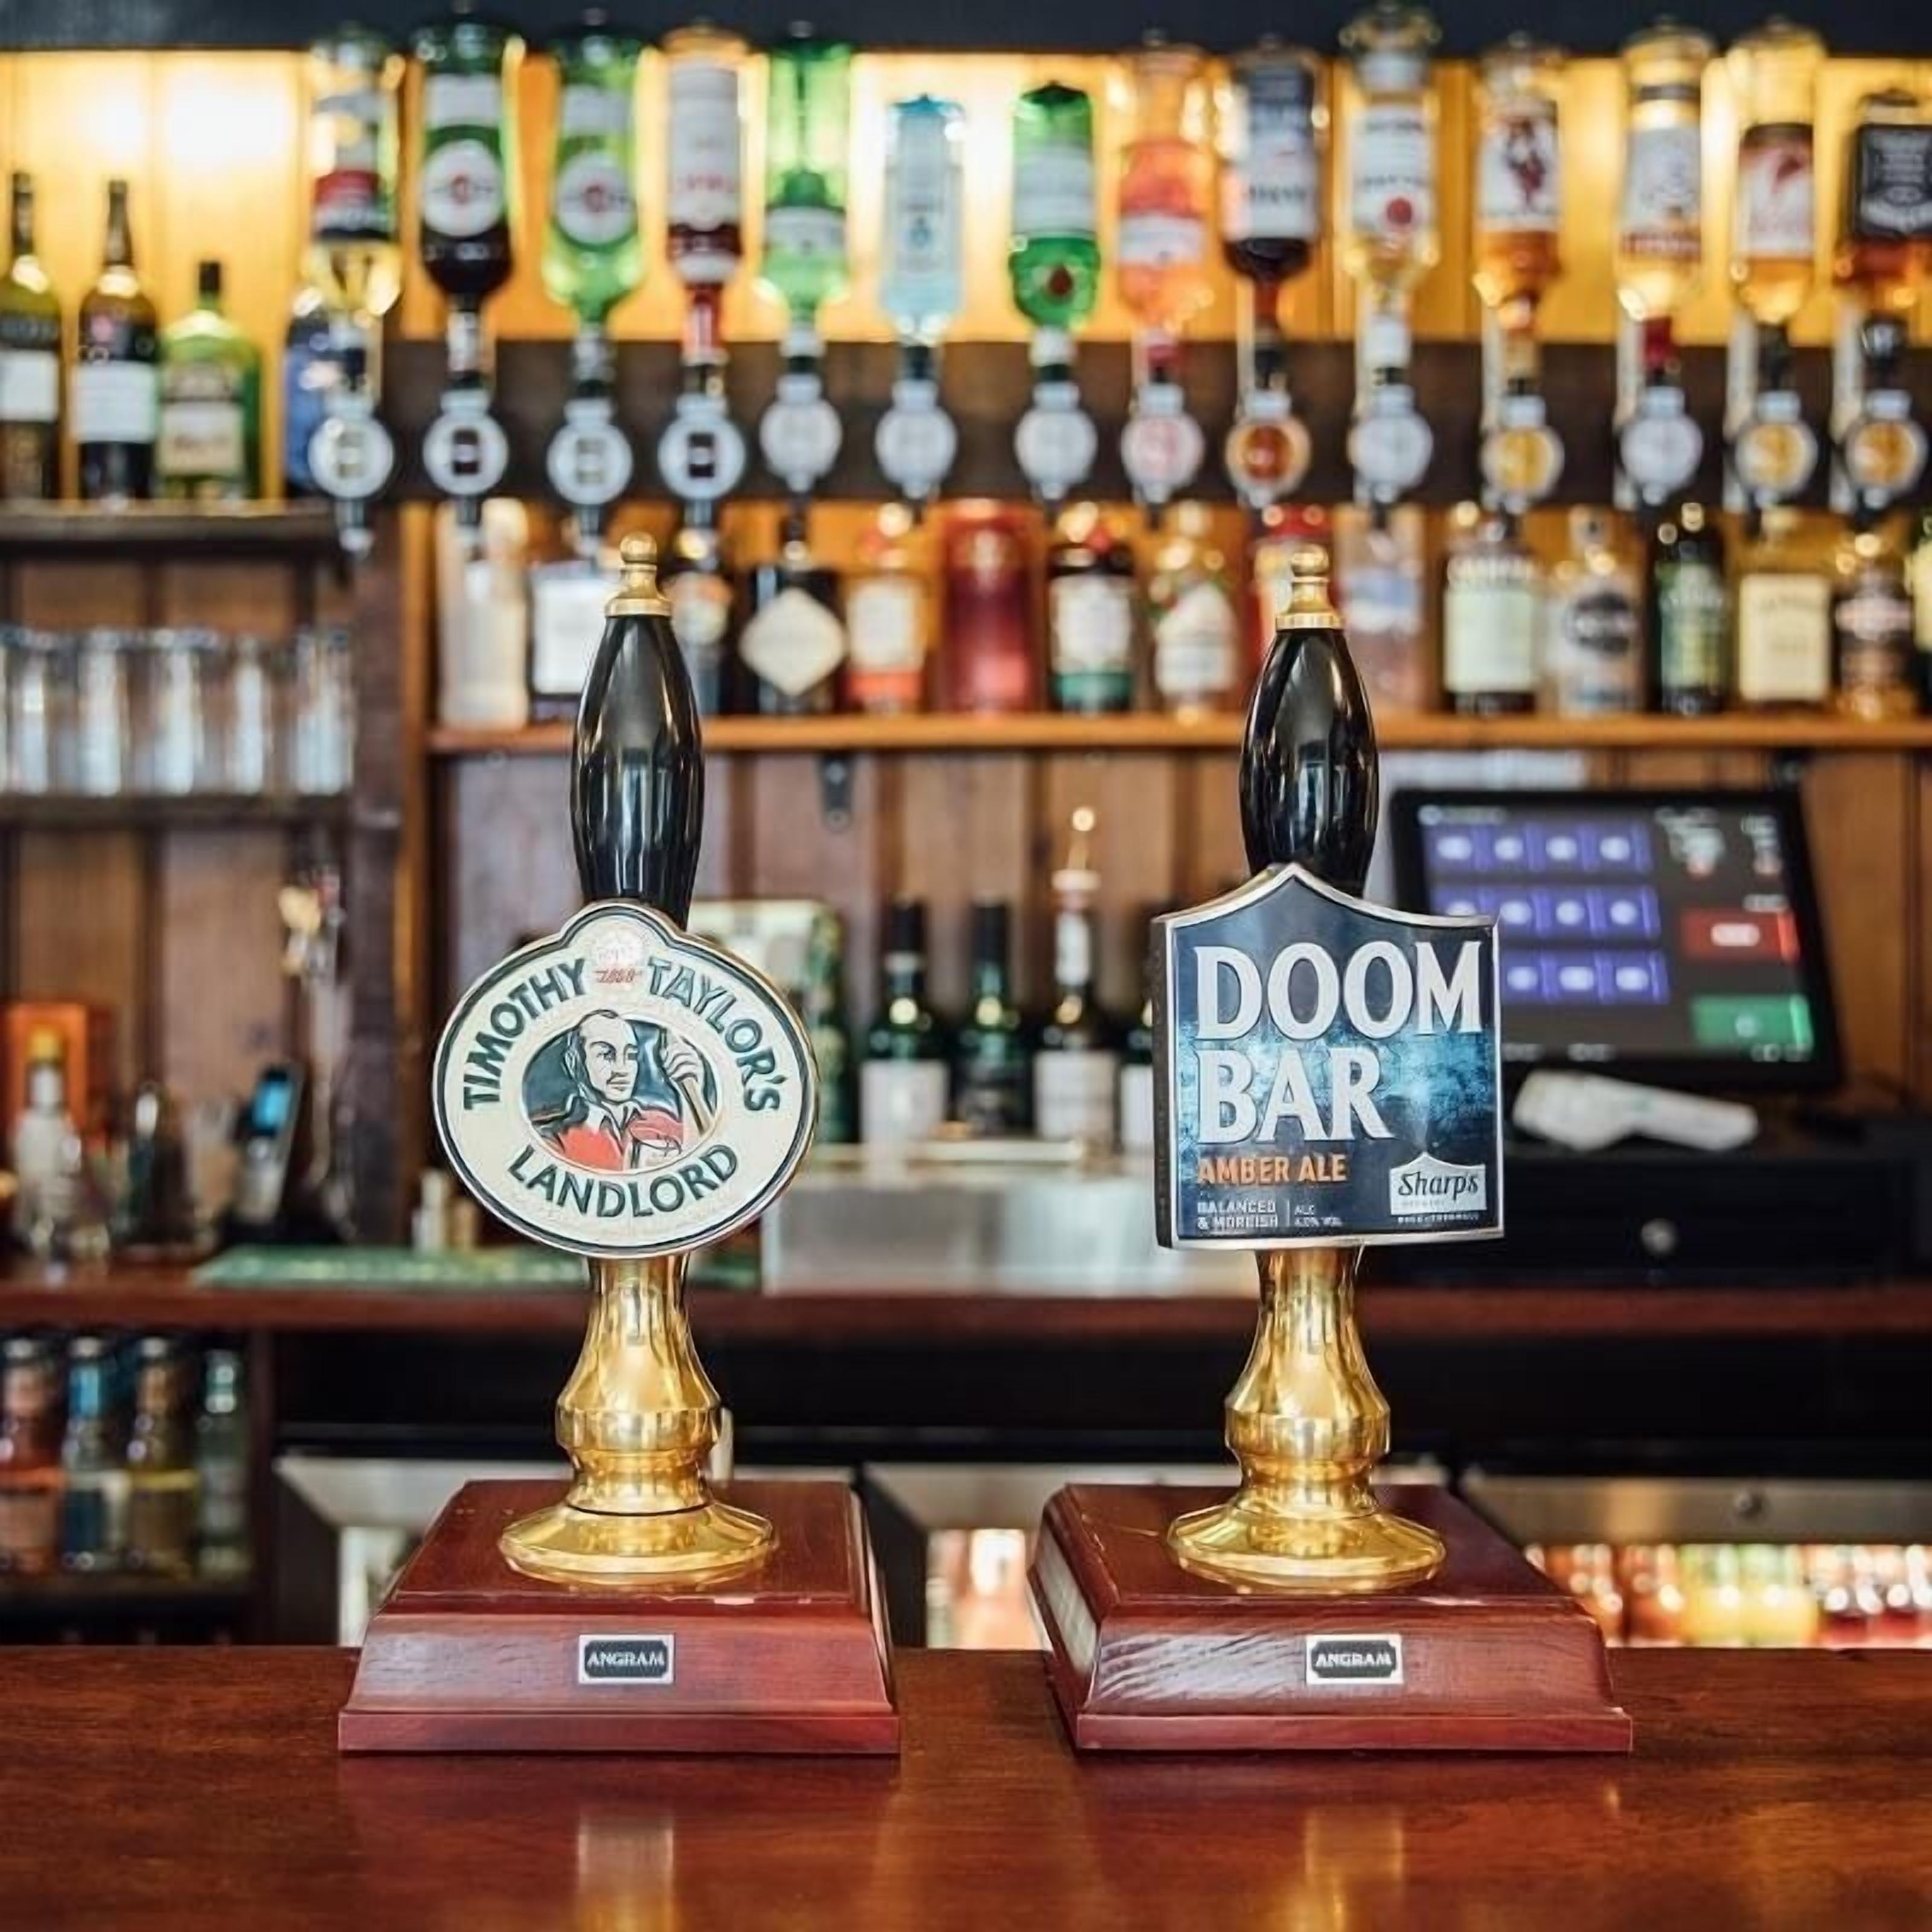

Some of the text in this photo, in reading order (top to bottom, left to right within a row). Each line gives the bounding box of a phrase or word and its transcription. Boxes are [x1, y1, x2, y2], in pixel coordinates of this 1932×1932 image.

[1193, 940, 1483, 1041] DOOM
[464, 956, 788, 1112] TIMOTHY TAYLOR'S
[1194, 1047, 1397, 1144] BAR
[507, 1144, 740, 1218] LANDLORD
[1197, 1152, 1348, 1185] AMBER ALE
[1398, 1171, 1479, 1201] Sharp's
[1197, 1200, 1276, 1214] BALANCED
[1198, 1217, 1209, 1230] &
[586, 1650, 665, 1668] ANGRAM
[1315, 1651, 1392, 1669] ANGRAM
